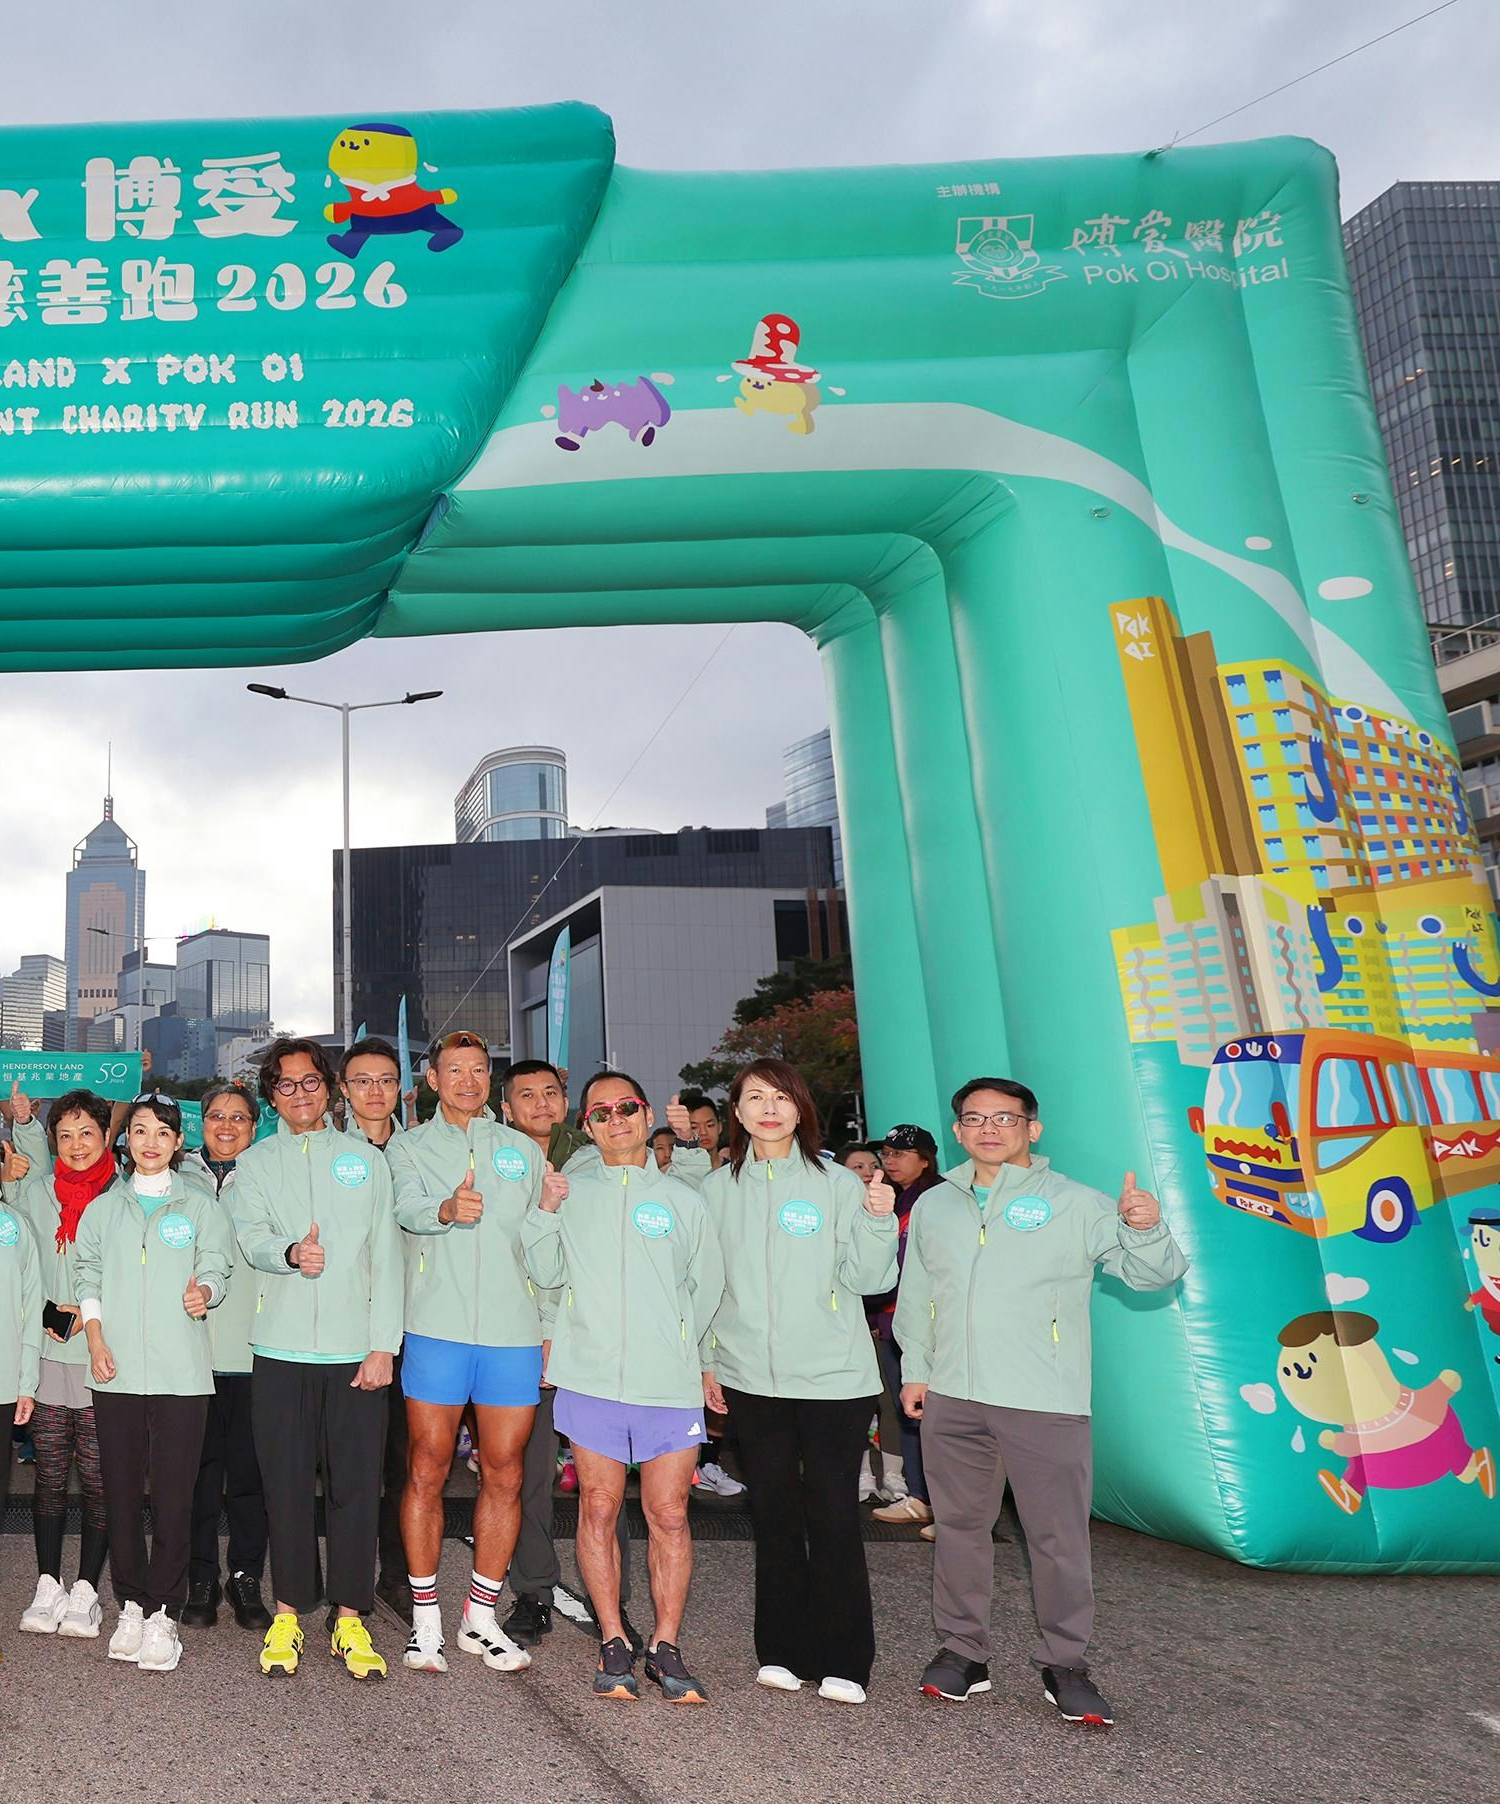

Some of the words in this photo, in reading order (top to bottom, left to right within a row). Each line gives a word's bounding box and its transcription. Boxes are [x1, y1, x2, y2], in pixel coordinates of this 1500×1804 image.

[81, 151, 299, 241] 博愛
[215, 261, 408, 312] 2026
[1083, 263, 1139, 285] Pok
[1146, 260, 1179, 281] Oi
[1185, 257, 1290, 290] Hospital
[101, 356, 132, 385] X
[156, 353, 237, 385] POK
[62, 402, 207, 434] CHARITY
[227, 400, 299, 431] RUN
[322, 398, 415, 428] 2026
[2, 1063, 58, 1071] HENDERSON
[59, 1063, 85, 1071] LAND
[2, 1071, 84, 1082] 恒基兆業地產
[95, 1062, 129, 1085] 50
